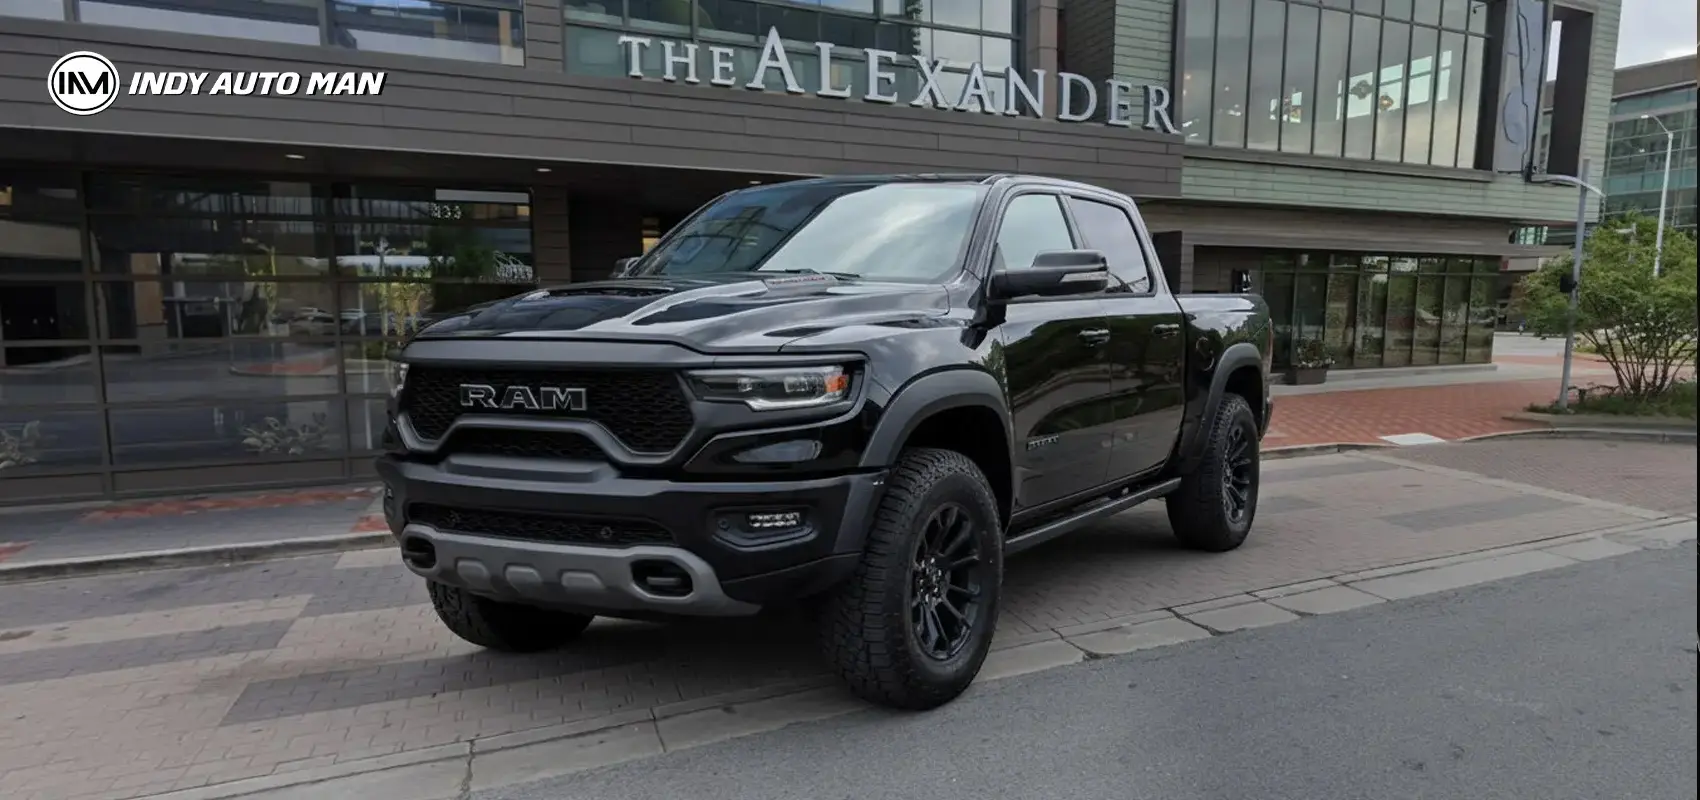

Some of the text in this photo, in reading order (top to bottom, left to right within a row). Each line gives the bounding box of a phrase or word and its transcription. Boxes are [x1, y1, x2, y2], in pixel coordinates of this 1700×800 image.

[618, 25, 1182, 134] THE ALEXANDER
[459, 383, 587, 411] RAM
